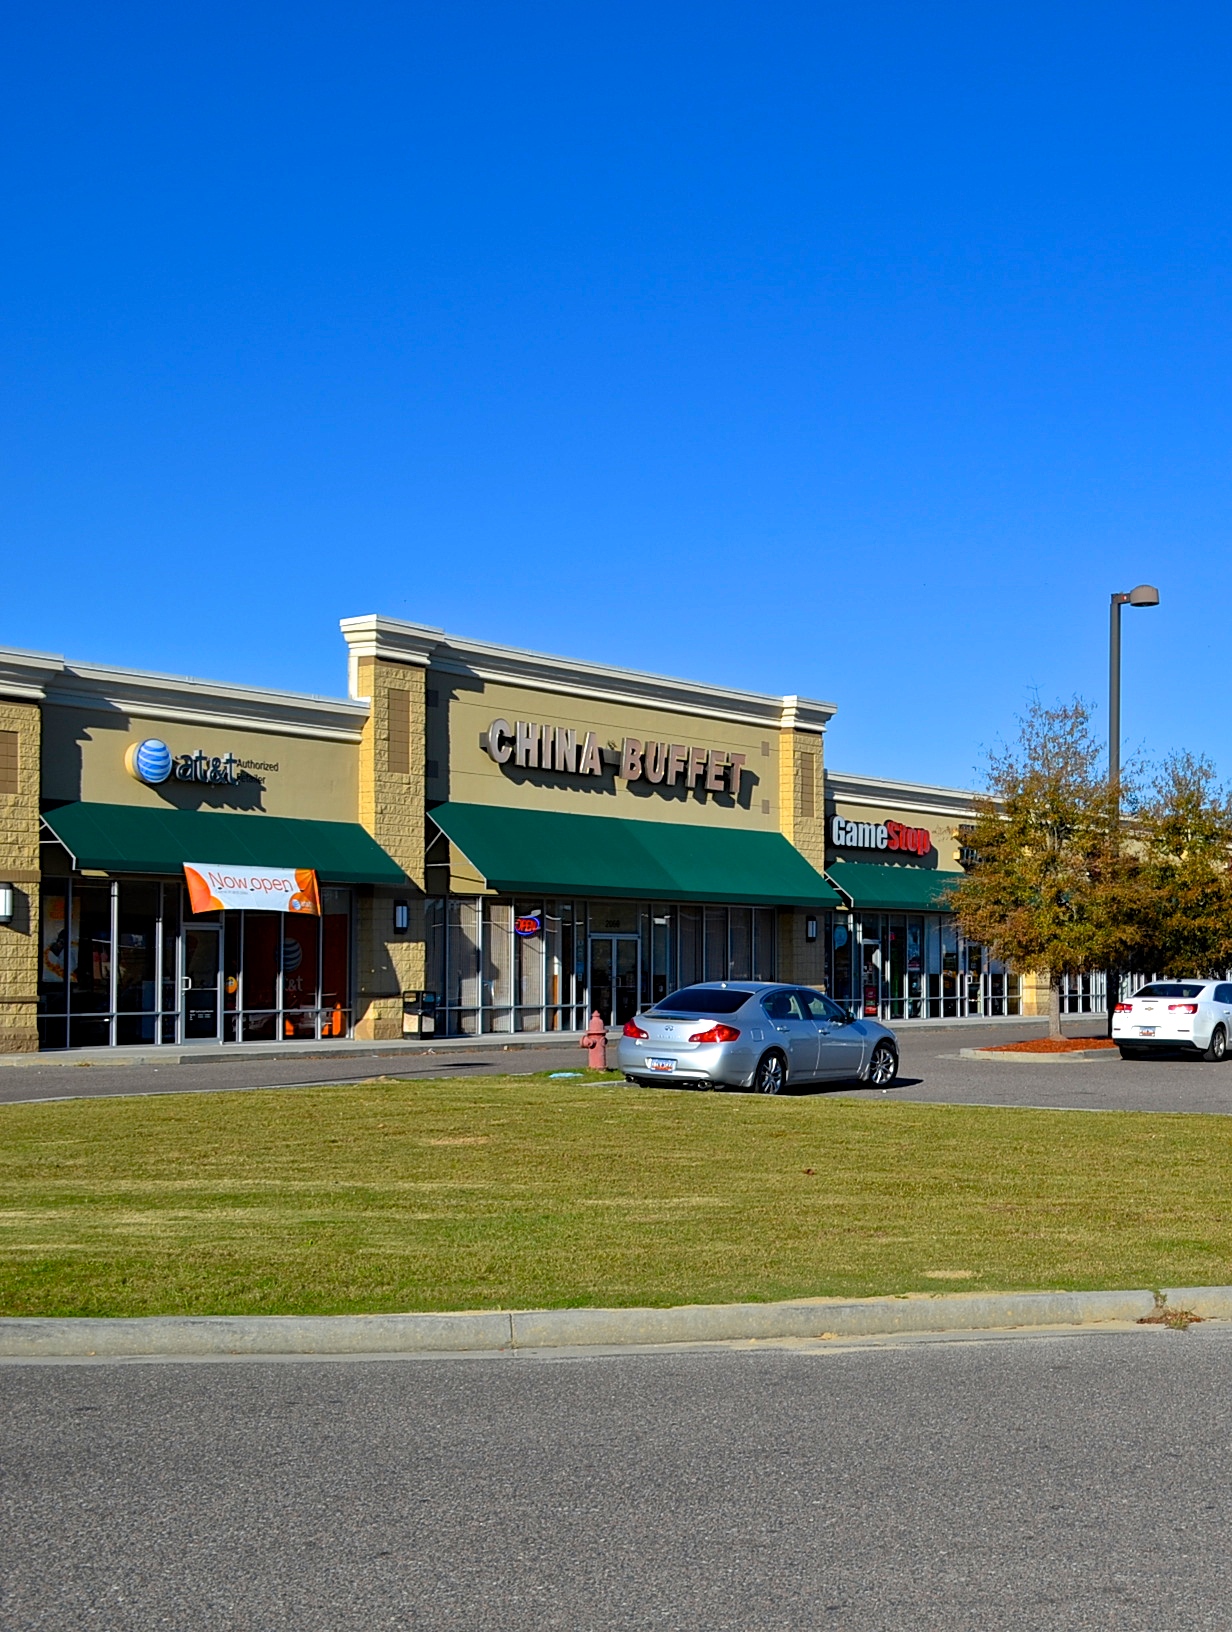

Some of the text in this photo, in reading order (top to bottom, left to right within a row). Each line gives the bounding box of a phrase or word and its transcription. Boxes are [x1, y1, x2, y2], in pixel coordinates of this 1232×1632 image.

[175, 750, 239, 786] at&t
[236, 758, 279, 772] Authorized
[488, 718, 746, 793] CHINA BUFFET
[831, 815, 931, 856] GameStop
[208, 872, 294, 894] Now open
